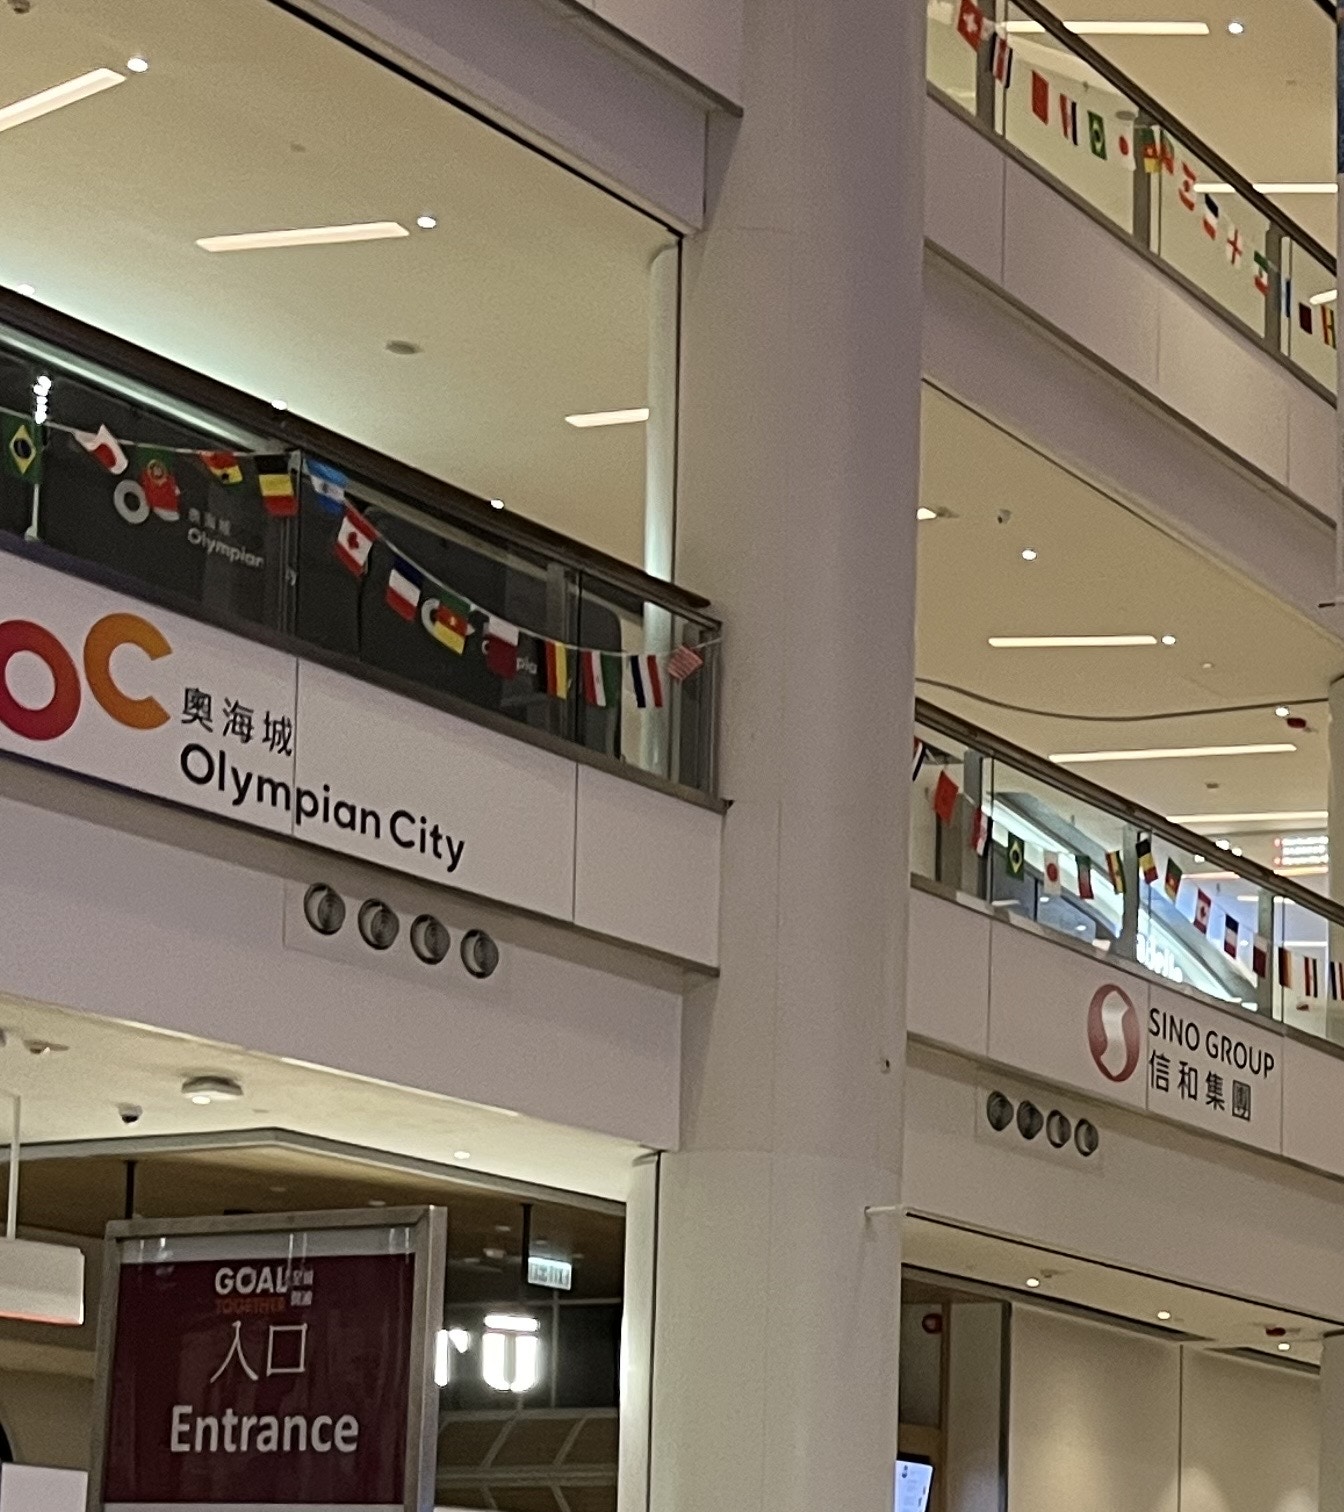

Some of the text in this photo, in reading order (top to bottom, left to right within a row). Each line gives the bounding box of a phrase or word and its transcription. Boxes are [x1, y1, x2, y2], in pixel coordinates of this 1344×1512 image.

[0, 612, 173, 742] OC
[180, 742, 466, 874] Olympian City
[1148, 1007, 1275, 1080] SINO GROUP
[1148, 1049, 1252, 1122] 信和集團
[215, 1266, 288, 1295] GOAL
[210, 1319, 308, 1384] 入口
[170, 1404, 360, 1454] Entrance
